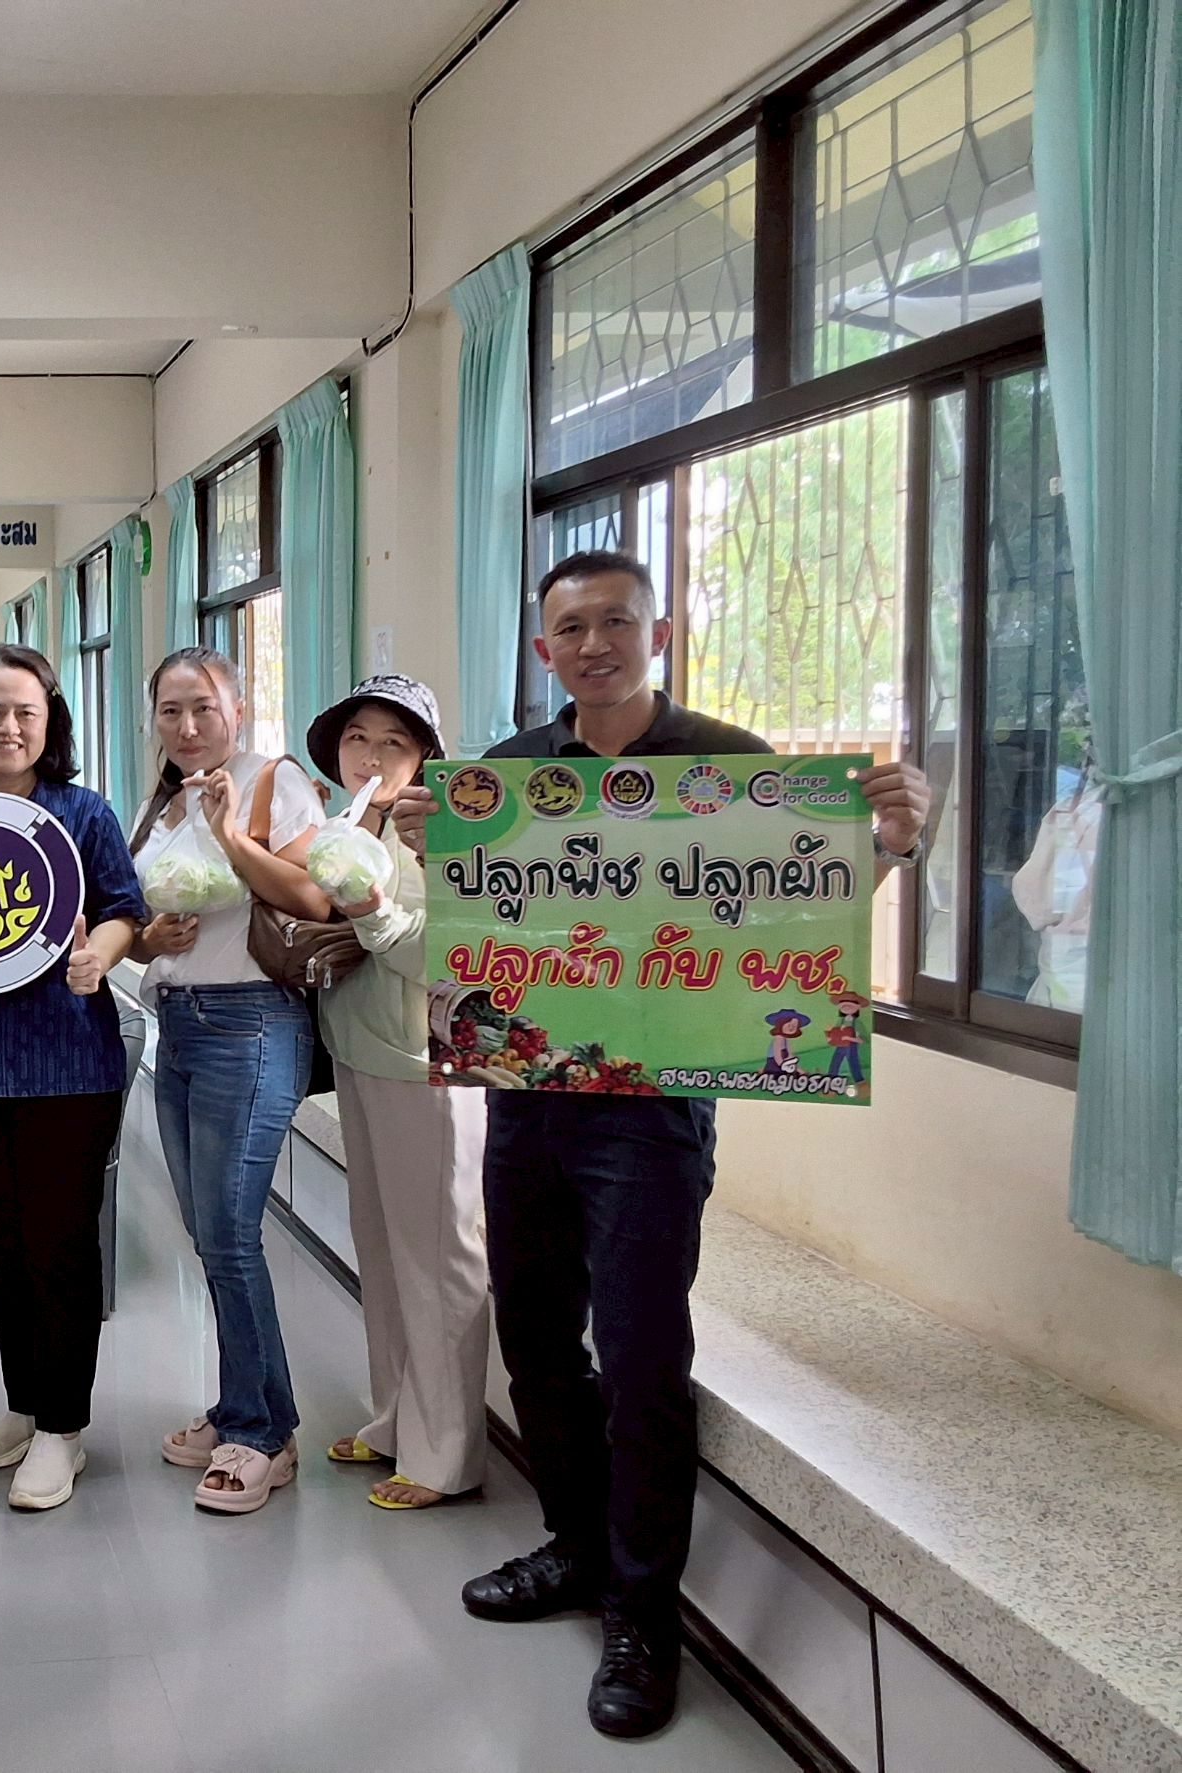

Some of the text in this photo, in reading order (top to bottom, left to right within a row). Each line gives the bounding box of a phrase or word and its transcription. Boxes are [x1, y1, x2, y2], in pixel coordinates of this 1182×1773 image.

[783, 791, 847, 804] for Good
[444, 831, 854, 928] ปลูกพืช ปลูกผัก
[447, 922, 846, 1013] ปลูกรัก กับ พช.
